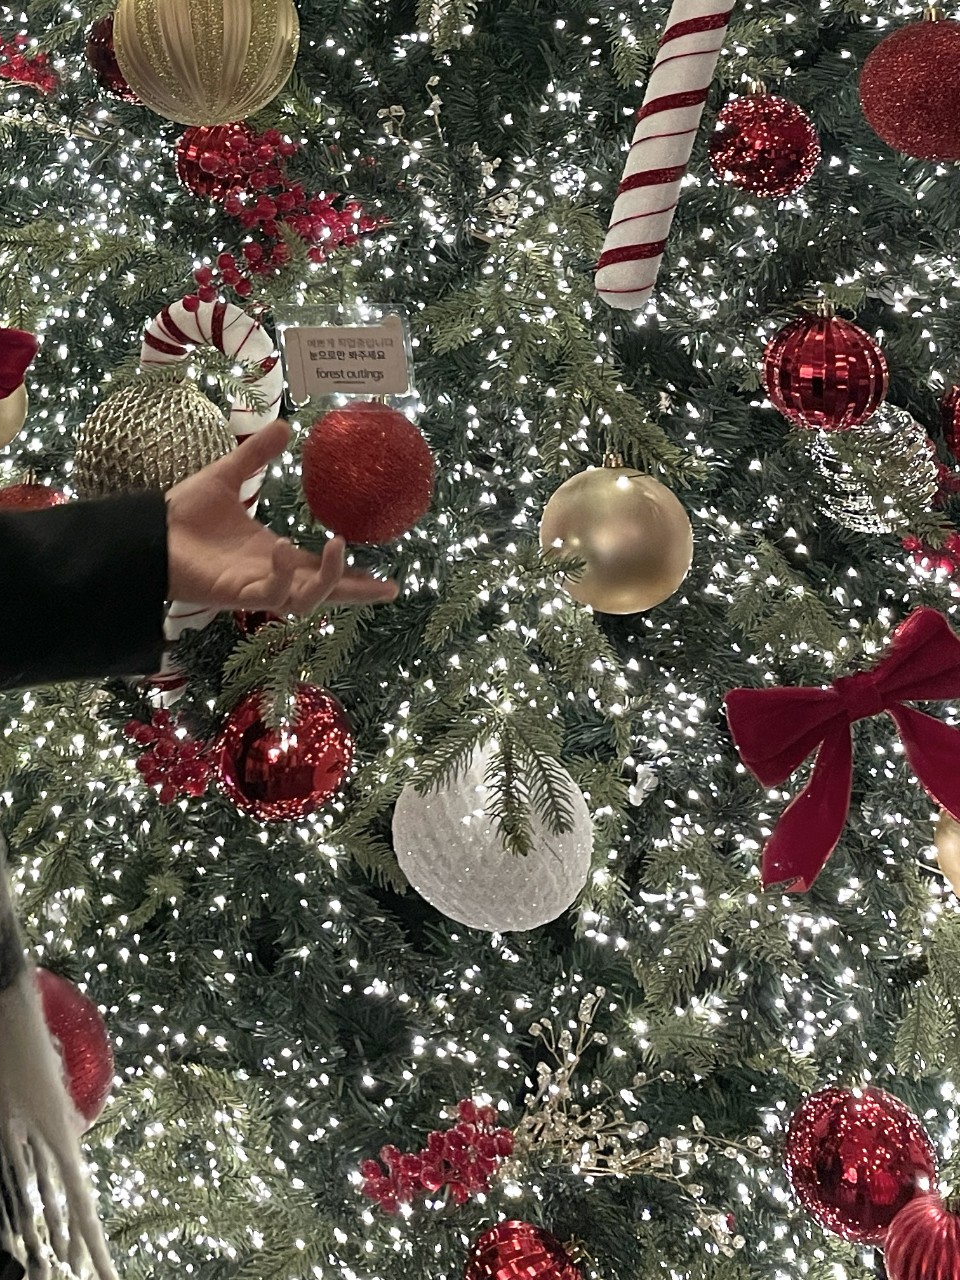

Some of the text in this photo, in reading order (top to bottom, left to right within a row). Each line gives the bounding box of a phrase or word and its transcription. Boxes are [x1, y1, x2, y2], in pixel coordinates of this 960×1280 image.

[309, 350, 386, 361] 눈으로만 봐주세요
[316, 367, 384, 382] forest outings
